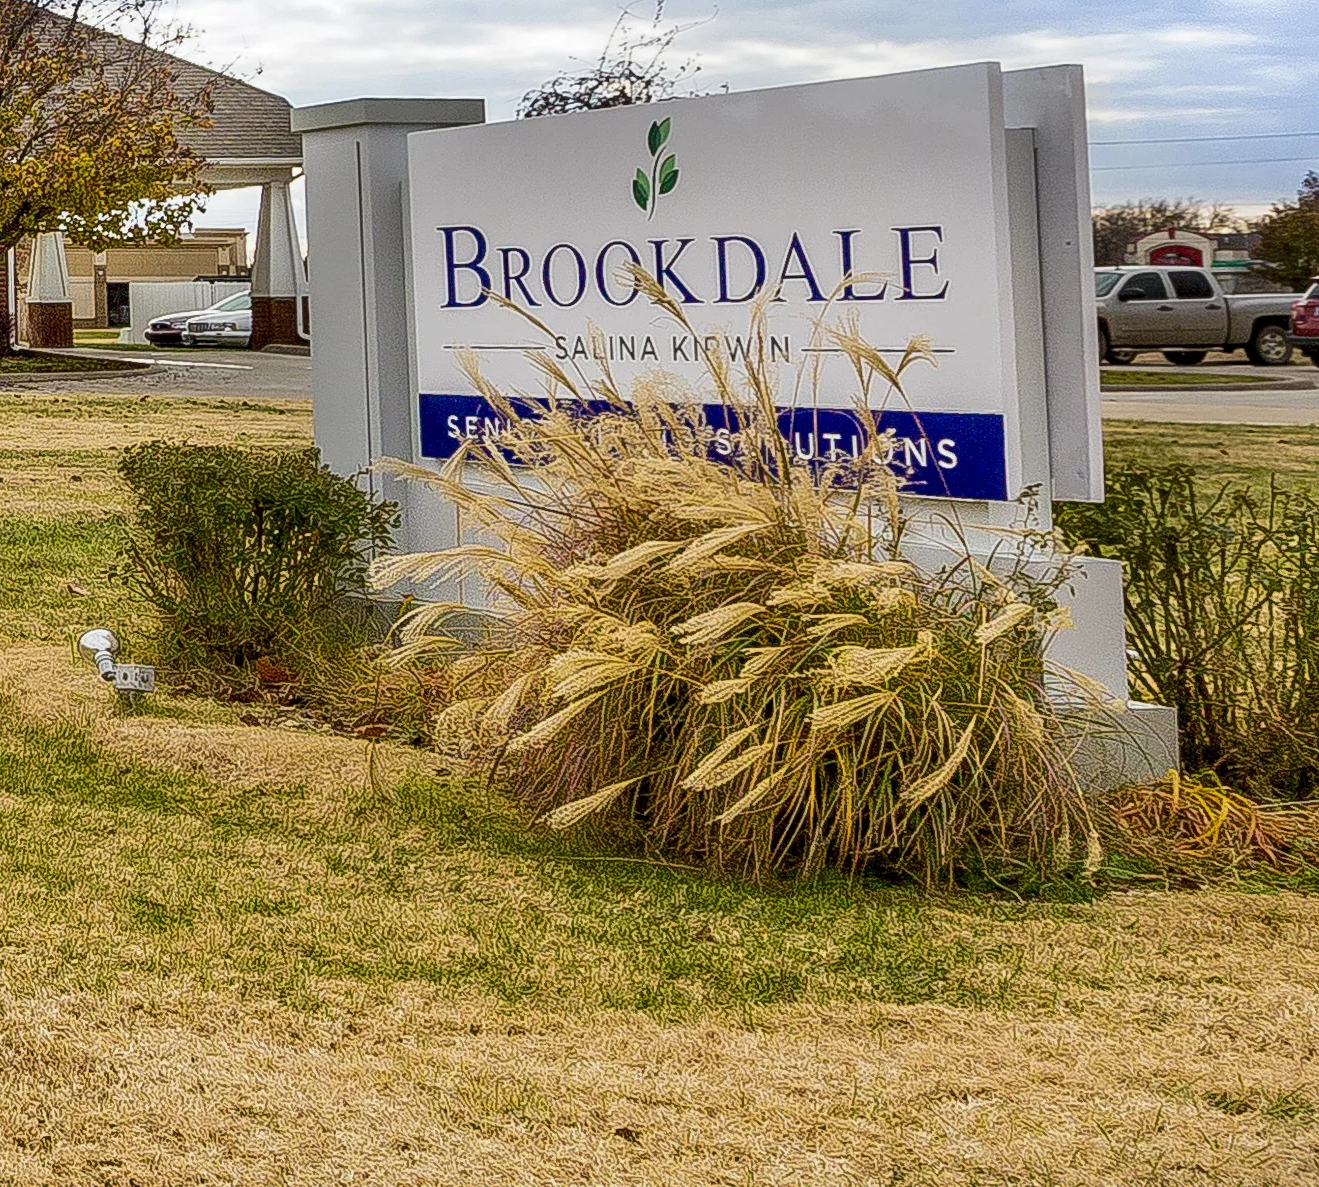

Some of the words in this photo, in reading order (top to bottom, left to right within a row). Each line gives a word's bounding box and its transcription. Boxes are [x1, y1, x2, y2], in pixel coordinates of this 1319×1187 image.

[436, 225, 949, 309] BROOKDALE
[555, 335, 659, 361] SALINA
[672, 335, 790, 363] KIRWN
[447, 414, 529, 441] SENI
[715, 427, 959, 470] SUTINS
